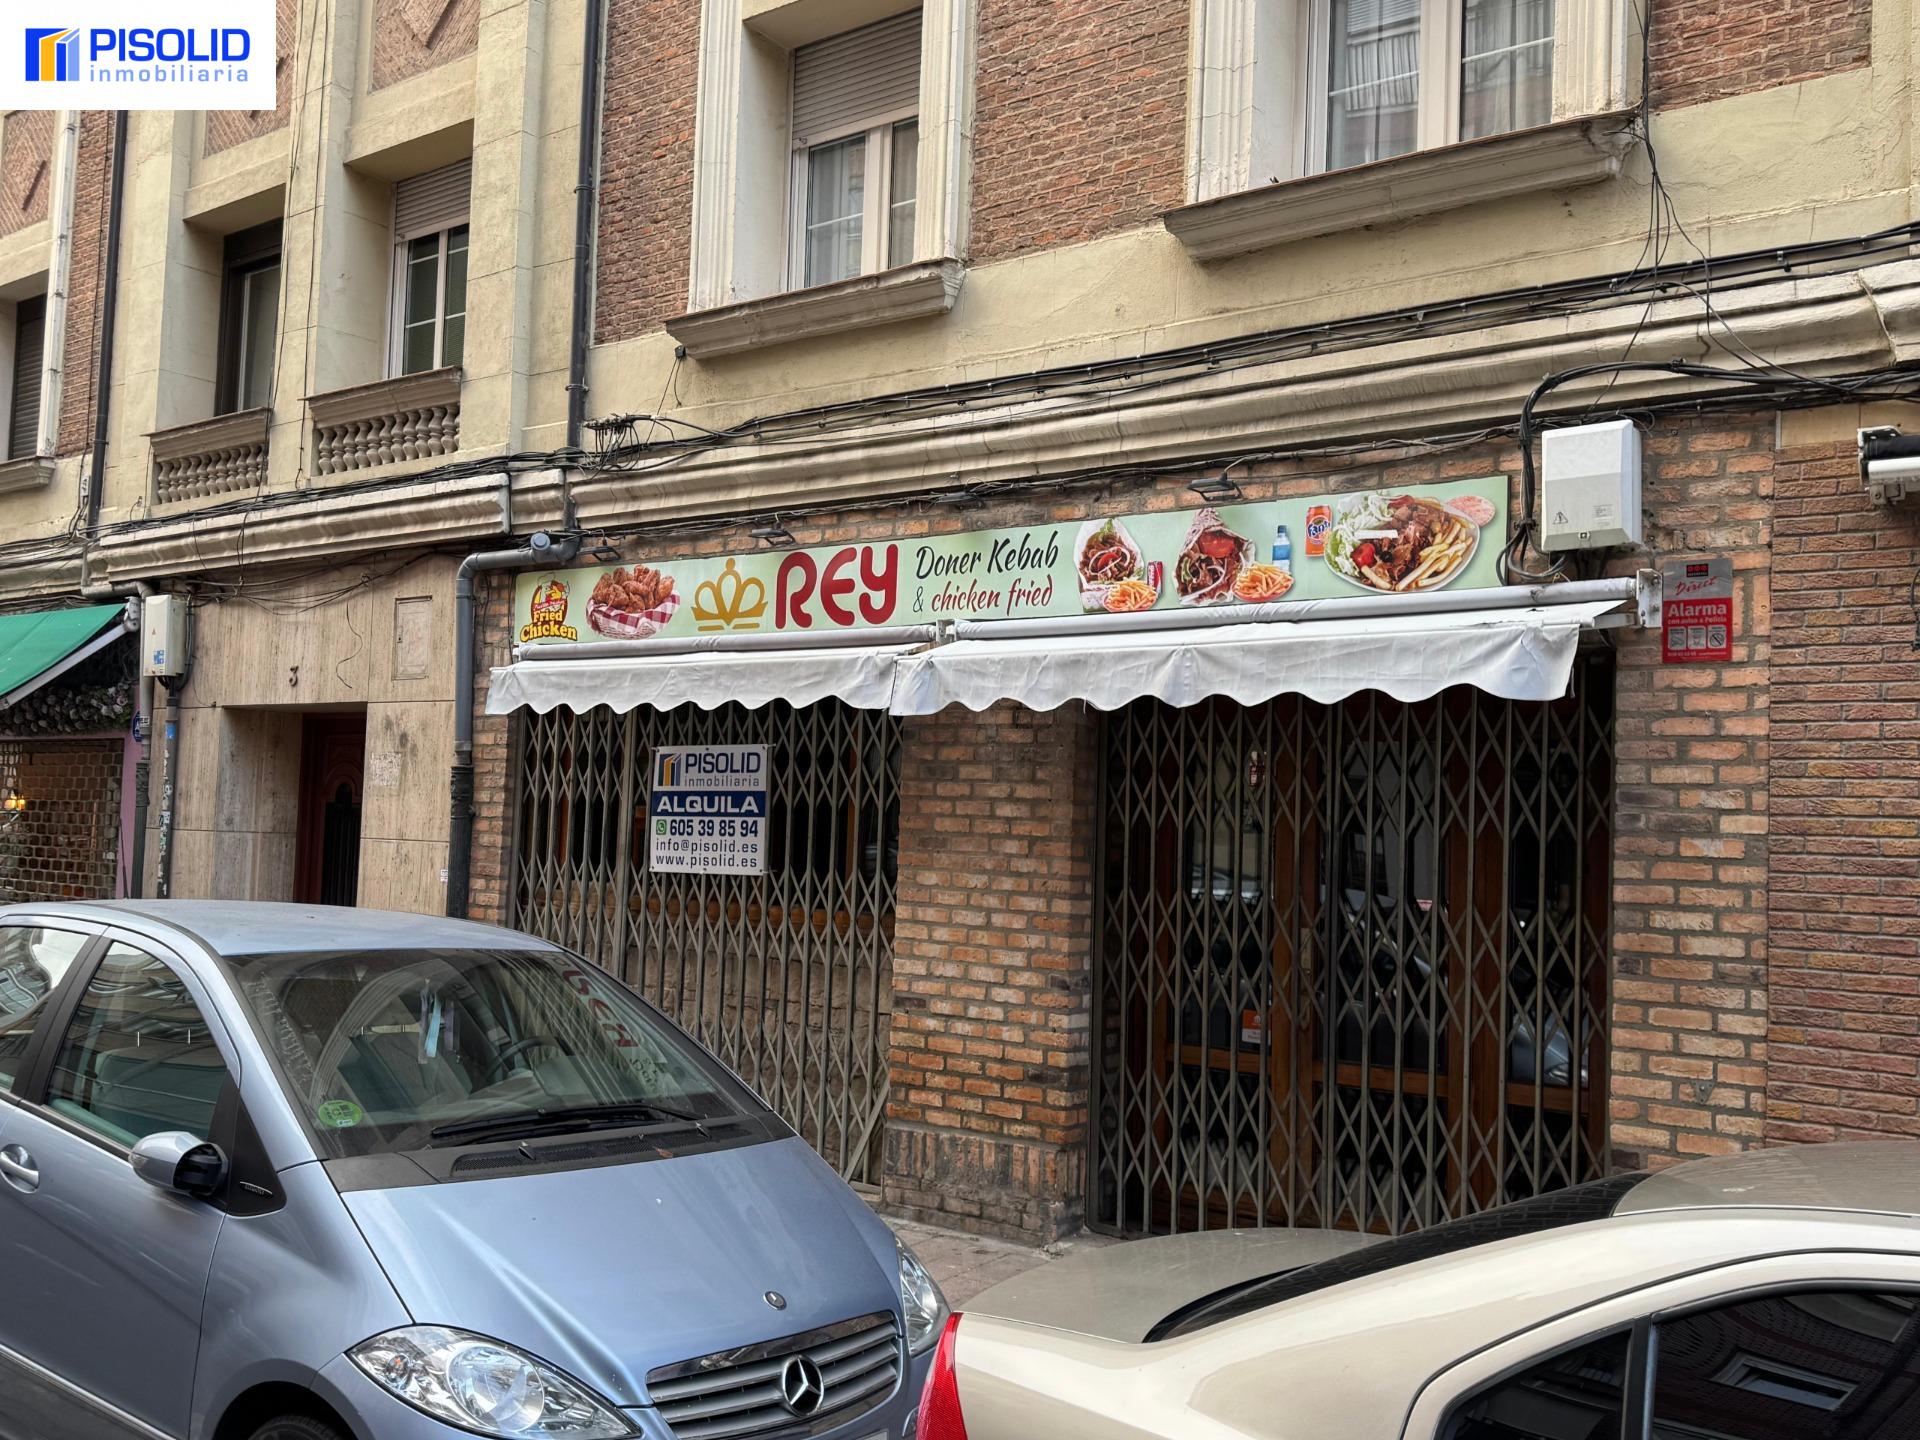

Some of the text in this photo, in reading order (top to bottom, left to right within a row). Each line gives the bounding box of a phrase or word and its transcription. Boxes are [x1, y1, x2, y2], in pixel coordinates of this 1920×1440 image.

[915, 530, 1059, 580] Doner Kebab
[775, 543, 899, 630] REY
[912, 573, 1053, 617] & chicken fried
[533, 609, 563, 622] Fried
[1668, 603, 1727, 617] Alarma
[520, 621, 578, 643] Chicken
[289, 665, 299, 688] 3
[685, 753, 761, 773] PISOLID
[684, 775, 760, 787] inmobiliaria
[656, 795, 759, 813] ALQUILA
[669, 819, 758, 837] 605 39 85 94
[656, 838, 758, 854] info@pisolid.es
[656, 853, 757, 868] www.pisolid.es
